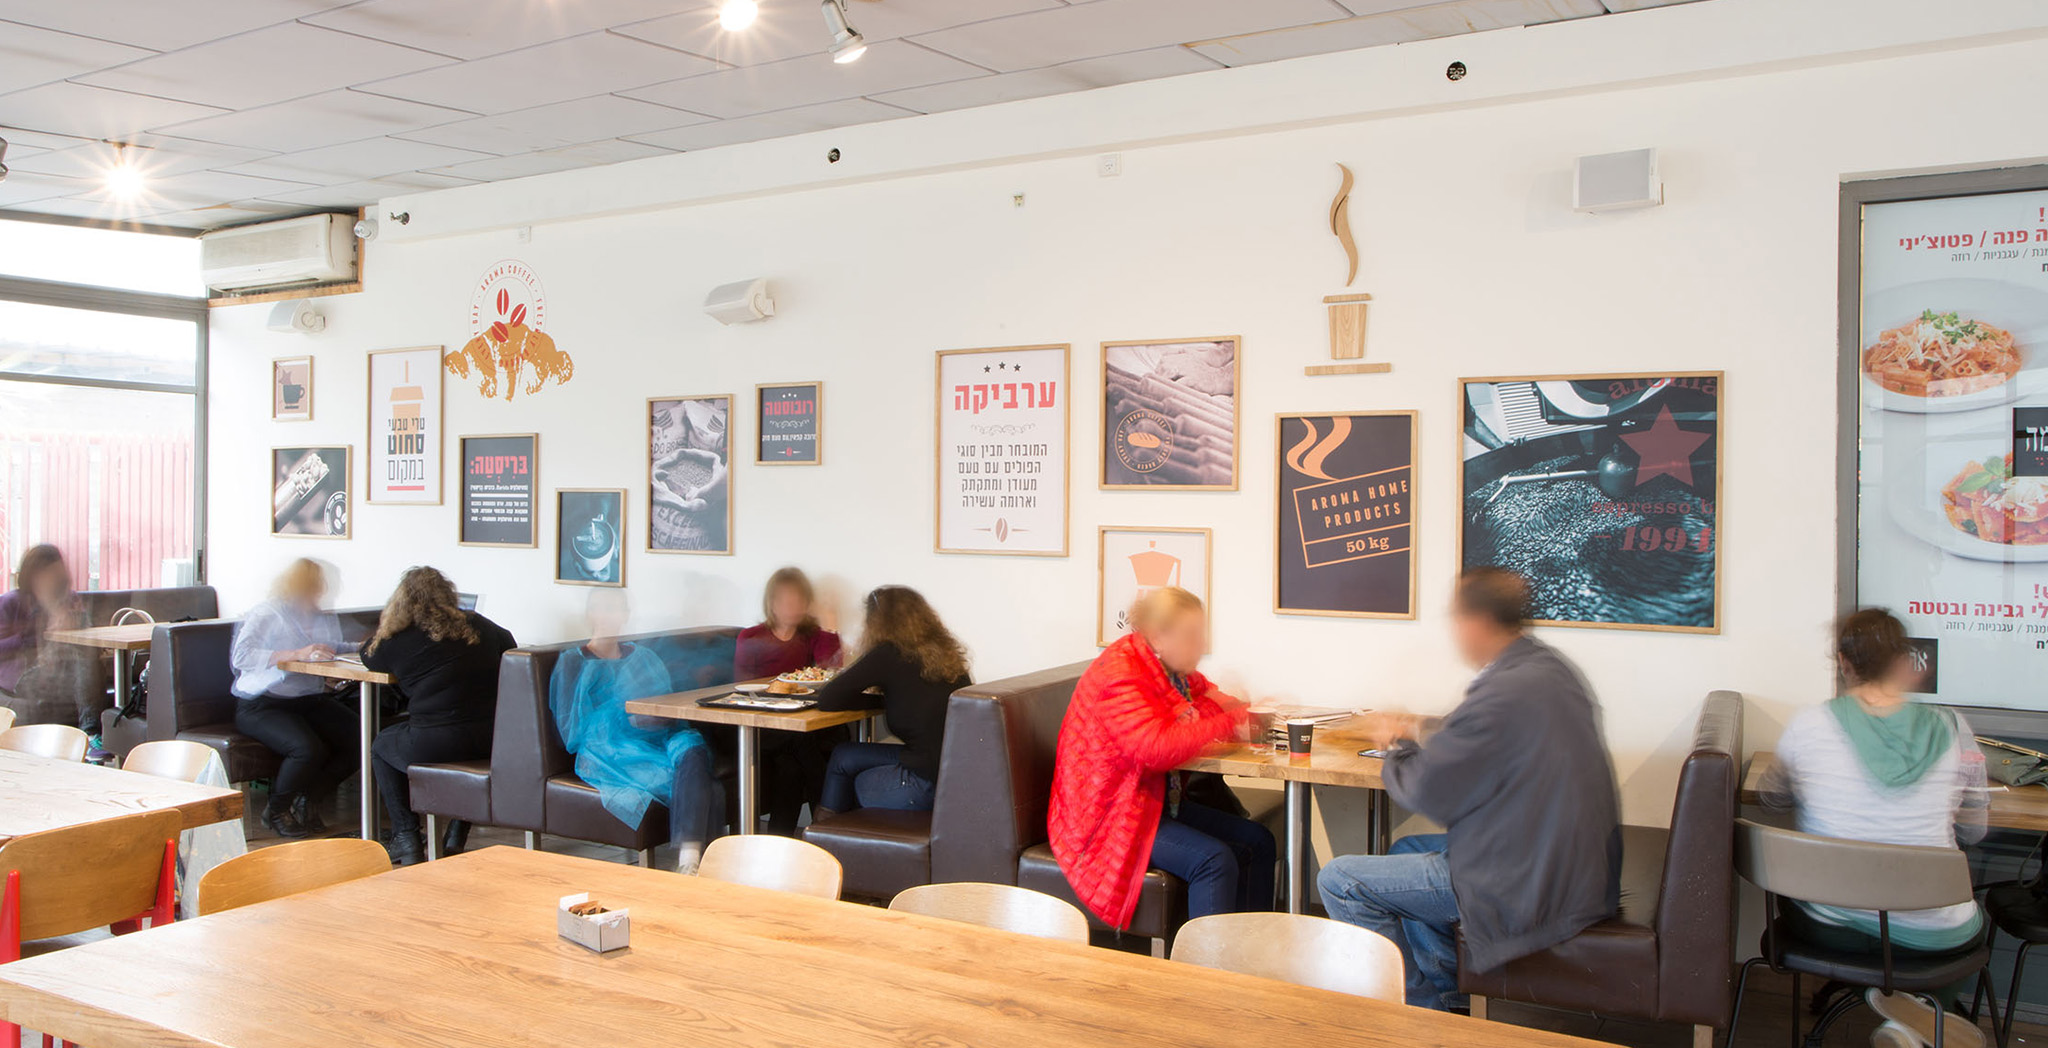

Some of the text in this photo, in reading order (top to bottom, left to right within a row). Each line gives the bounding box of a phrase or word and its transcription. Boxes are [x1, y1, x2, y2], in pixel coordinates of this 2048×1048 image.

[1993, 230, 2028, 245] פנה
[1951, 253, 1971, 262] רוזה
[1983, 249, 2019, 260] עגבניות
[480, 264, 535, 291] AROMA COFFEE
[955, 381, 1056, 415] ערביקה
[765, 400, 814, 416] רובוסטה
[388, 417, 425, 431] טרי טבעי
[388, 433, 425, 455] סחוט
[957, 443, 1048, 459] המובחר מבין סוגי
[388, 459, 424, 484] במקום
[958, 460, 1041, 474] הפולים עם טעם
[962, 478, 1037, 493] מעודן ומתקתק
[962, 495, 1036, 509] וארומה עשירה
[1311, 480, 1408, 511] AROMA HOME
[1324, 502, 1401, 528] PRODUCTS
[1592, 501, 1691, 518] espresso
[1346, 537, 1390, 553] 50 kg
[1909, 601, 1967, 616] ובטטה
[1974, 603, 2024, 618] גבינה
[1945, 621, 1966, 631] רוזה
[1977, 622, 2014, 633] עגבניות
